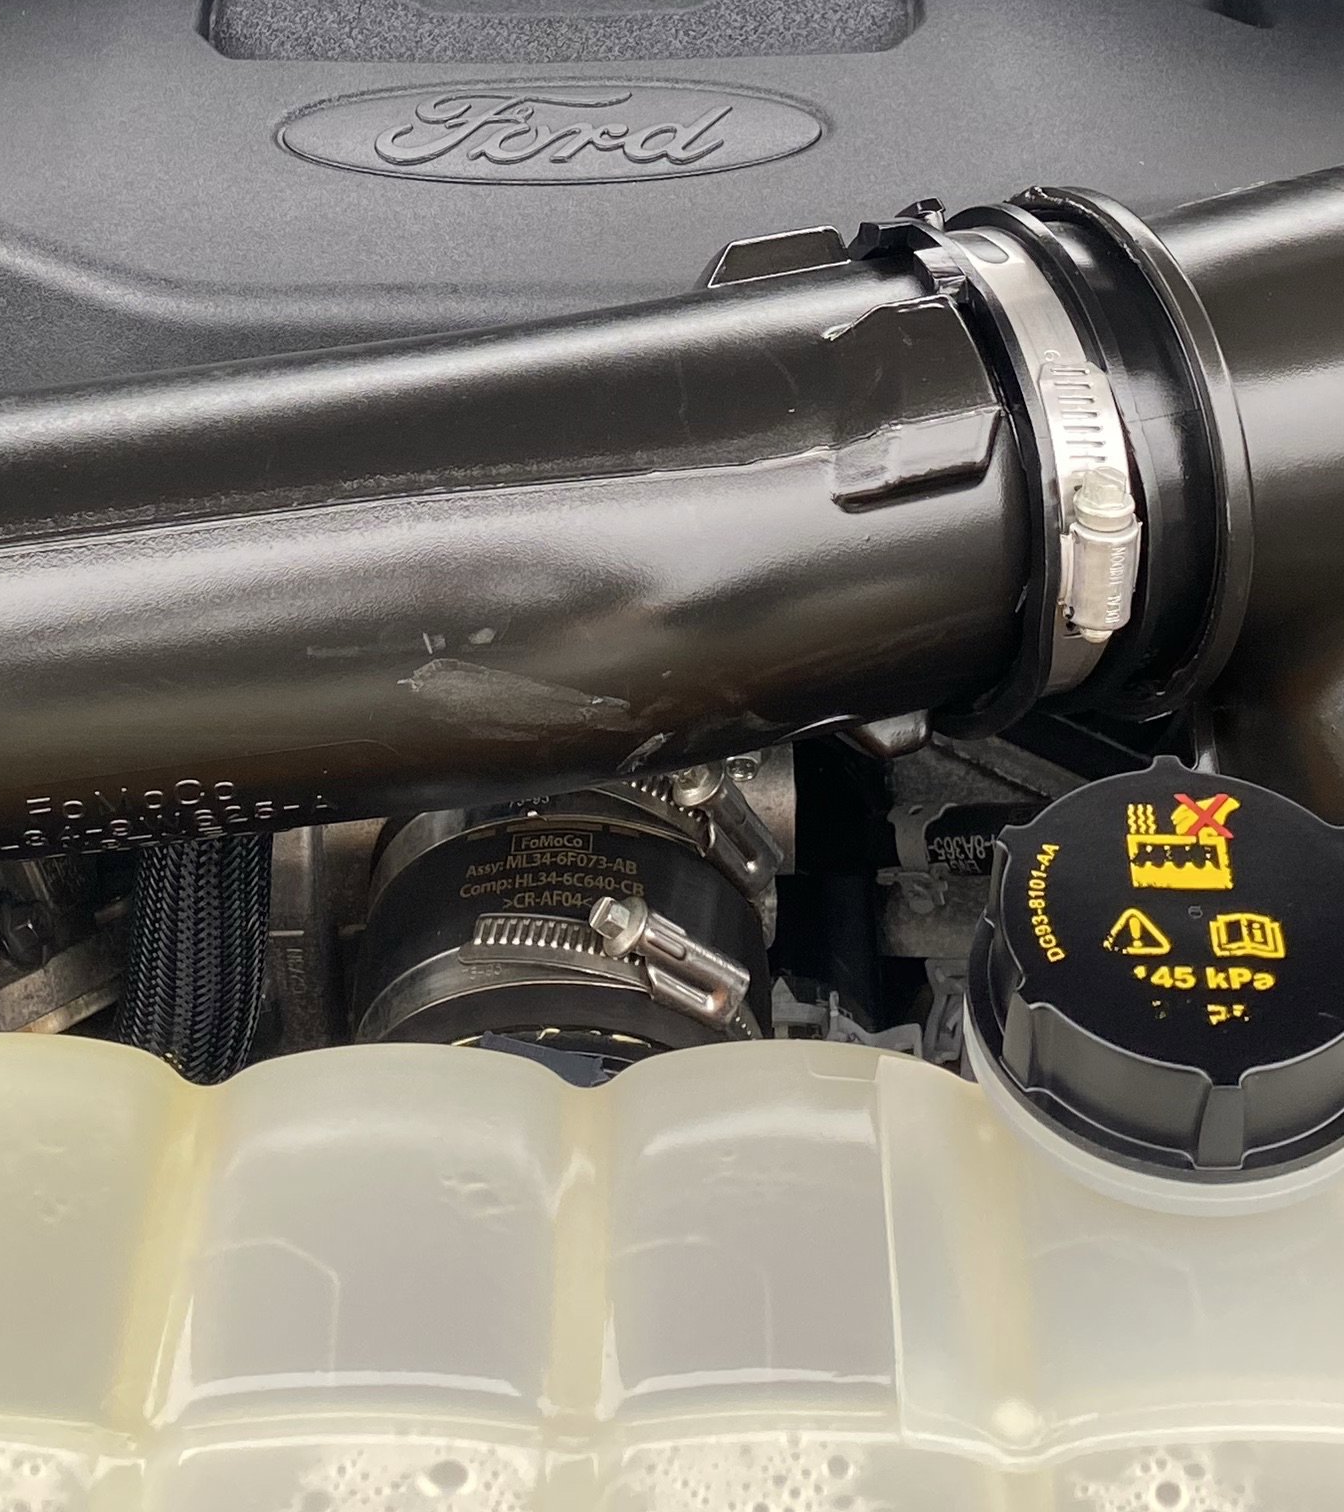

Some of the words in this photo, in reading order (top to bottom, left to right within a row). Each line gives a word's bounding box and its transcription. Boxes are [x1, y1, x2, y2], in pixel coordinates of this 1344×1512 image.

[374, 90, 734, 166] Ford
[521, 833, 584, 850] FoMoCo
[465, 860, 505, 879] Assy:
[506, 852, 638, 875] ML34-6F073-AB
[459, 878, 513, 899] Comp:
[1205, 966, 1277, 991] kPa
